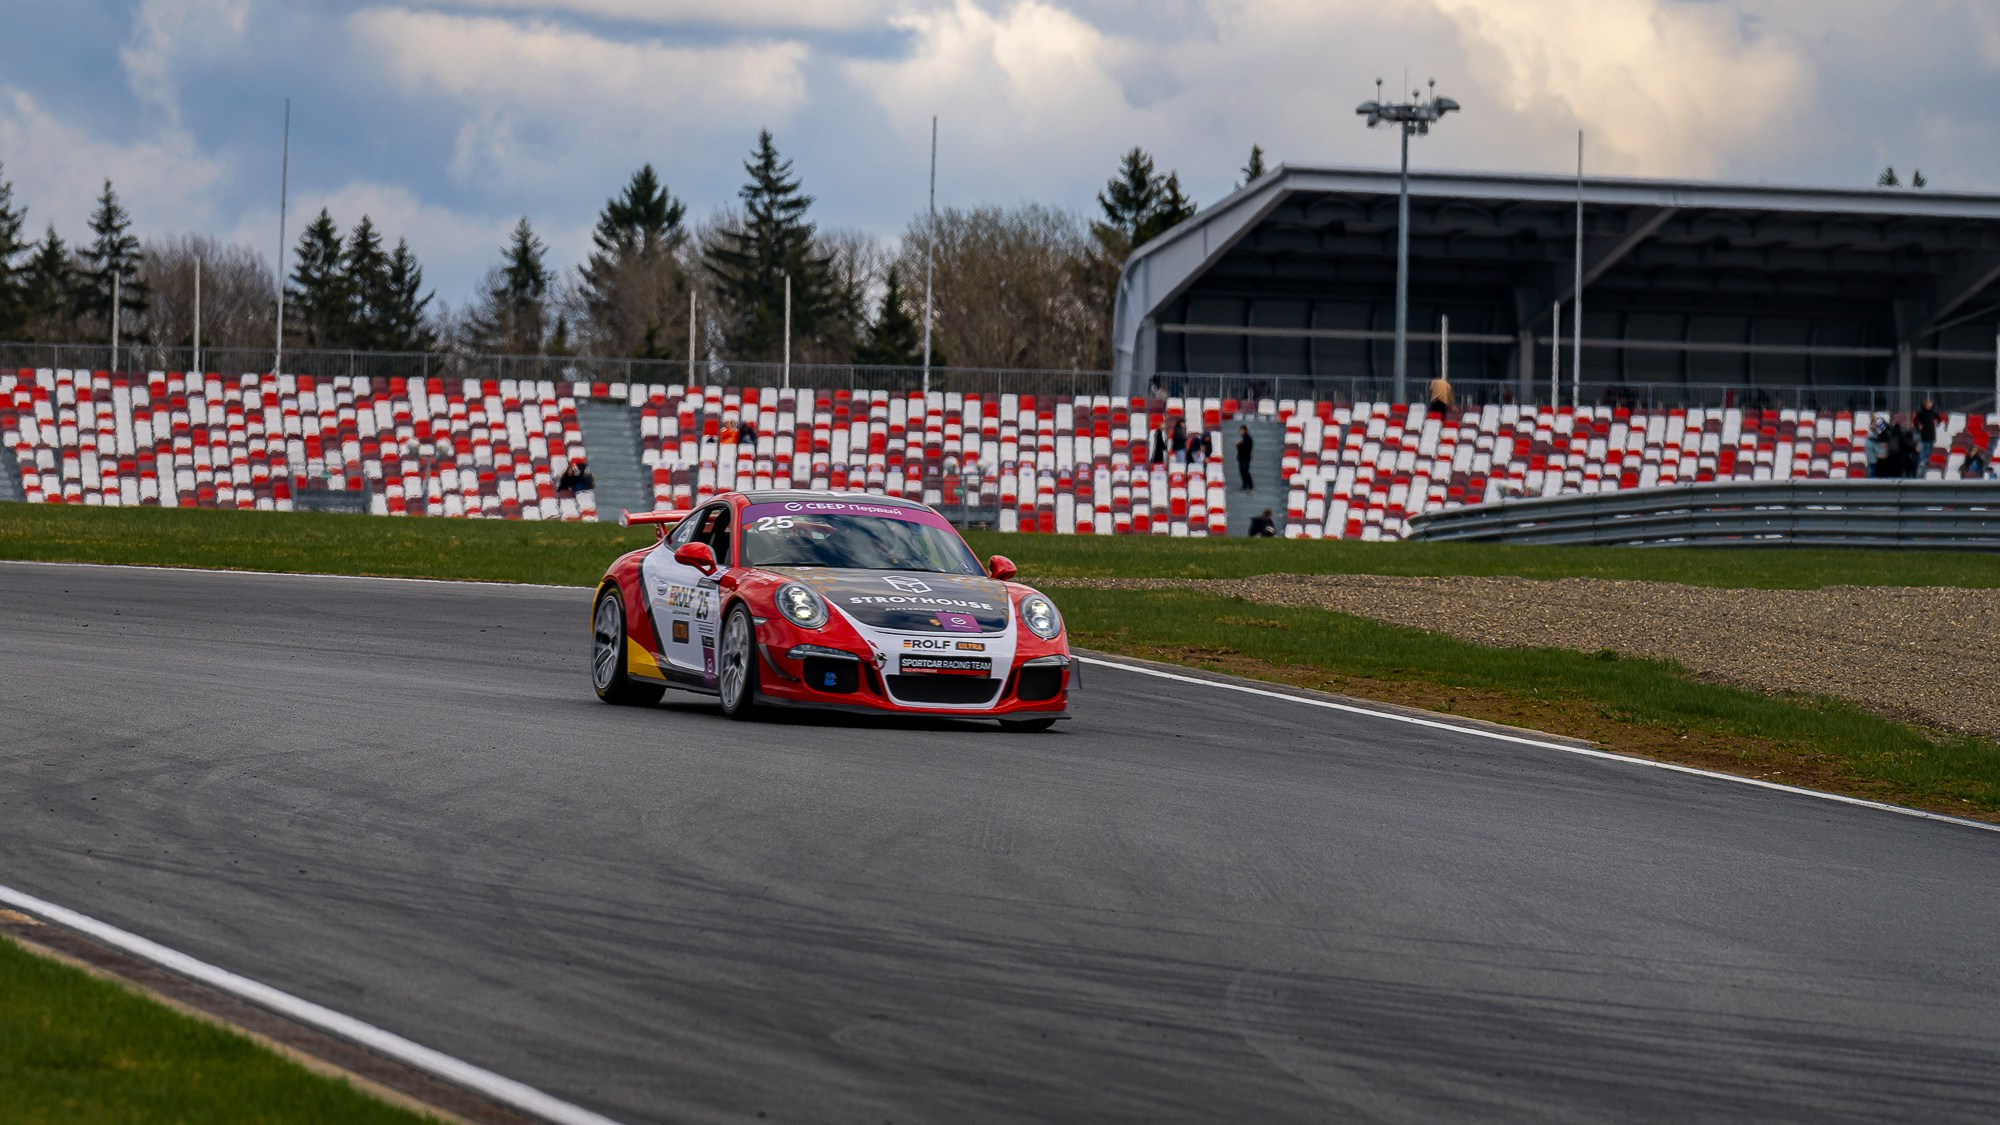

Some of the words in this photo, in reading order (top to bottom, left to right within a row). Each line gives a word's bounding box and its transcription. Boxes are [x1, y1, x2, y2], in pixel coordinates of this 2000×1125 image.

[806, 503, 845, 511] СБЕР
[850, 504, 902, 516] Первый
[757, 516, 794, 532] 25
[696, 589, 710, 620] 25
[850, 596, 993, 611] STROYHOUSE
[912, 639, 951, 650] ROLF
[958, 642, 983, 651] ULTRA
[901, 658, 942, 668] SPORTCAR
[943, 660, 970, 669] RACING
[971, 661, 992, 670] TEAM
